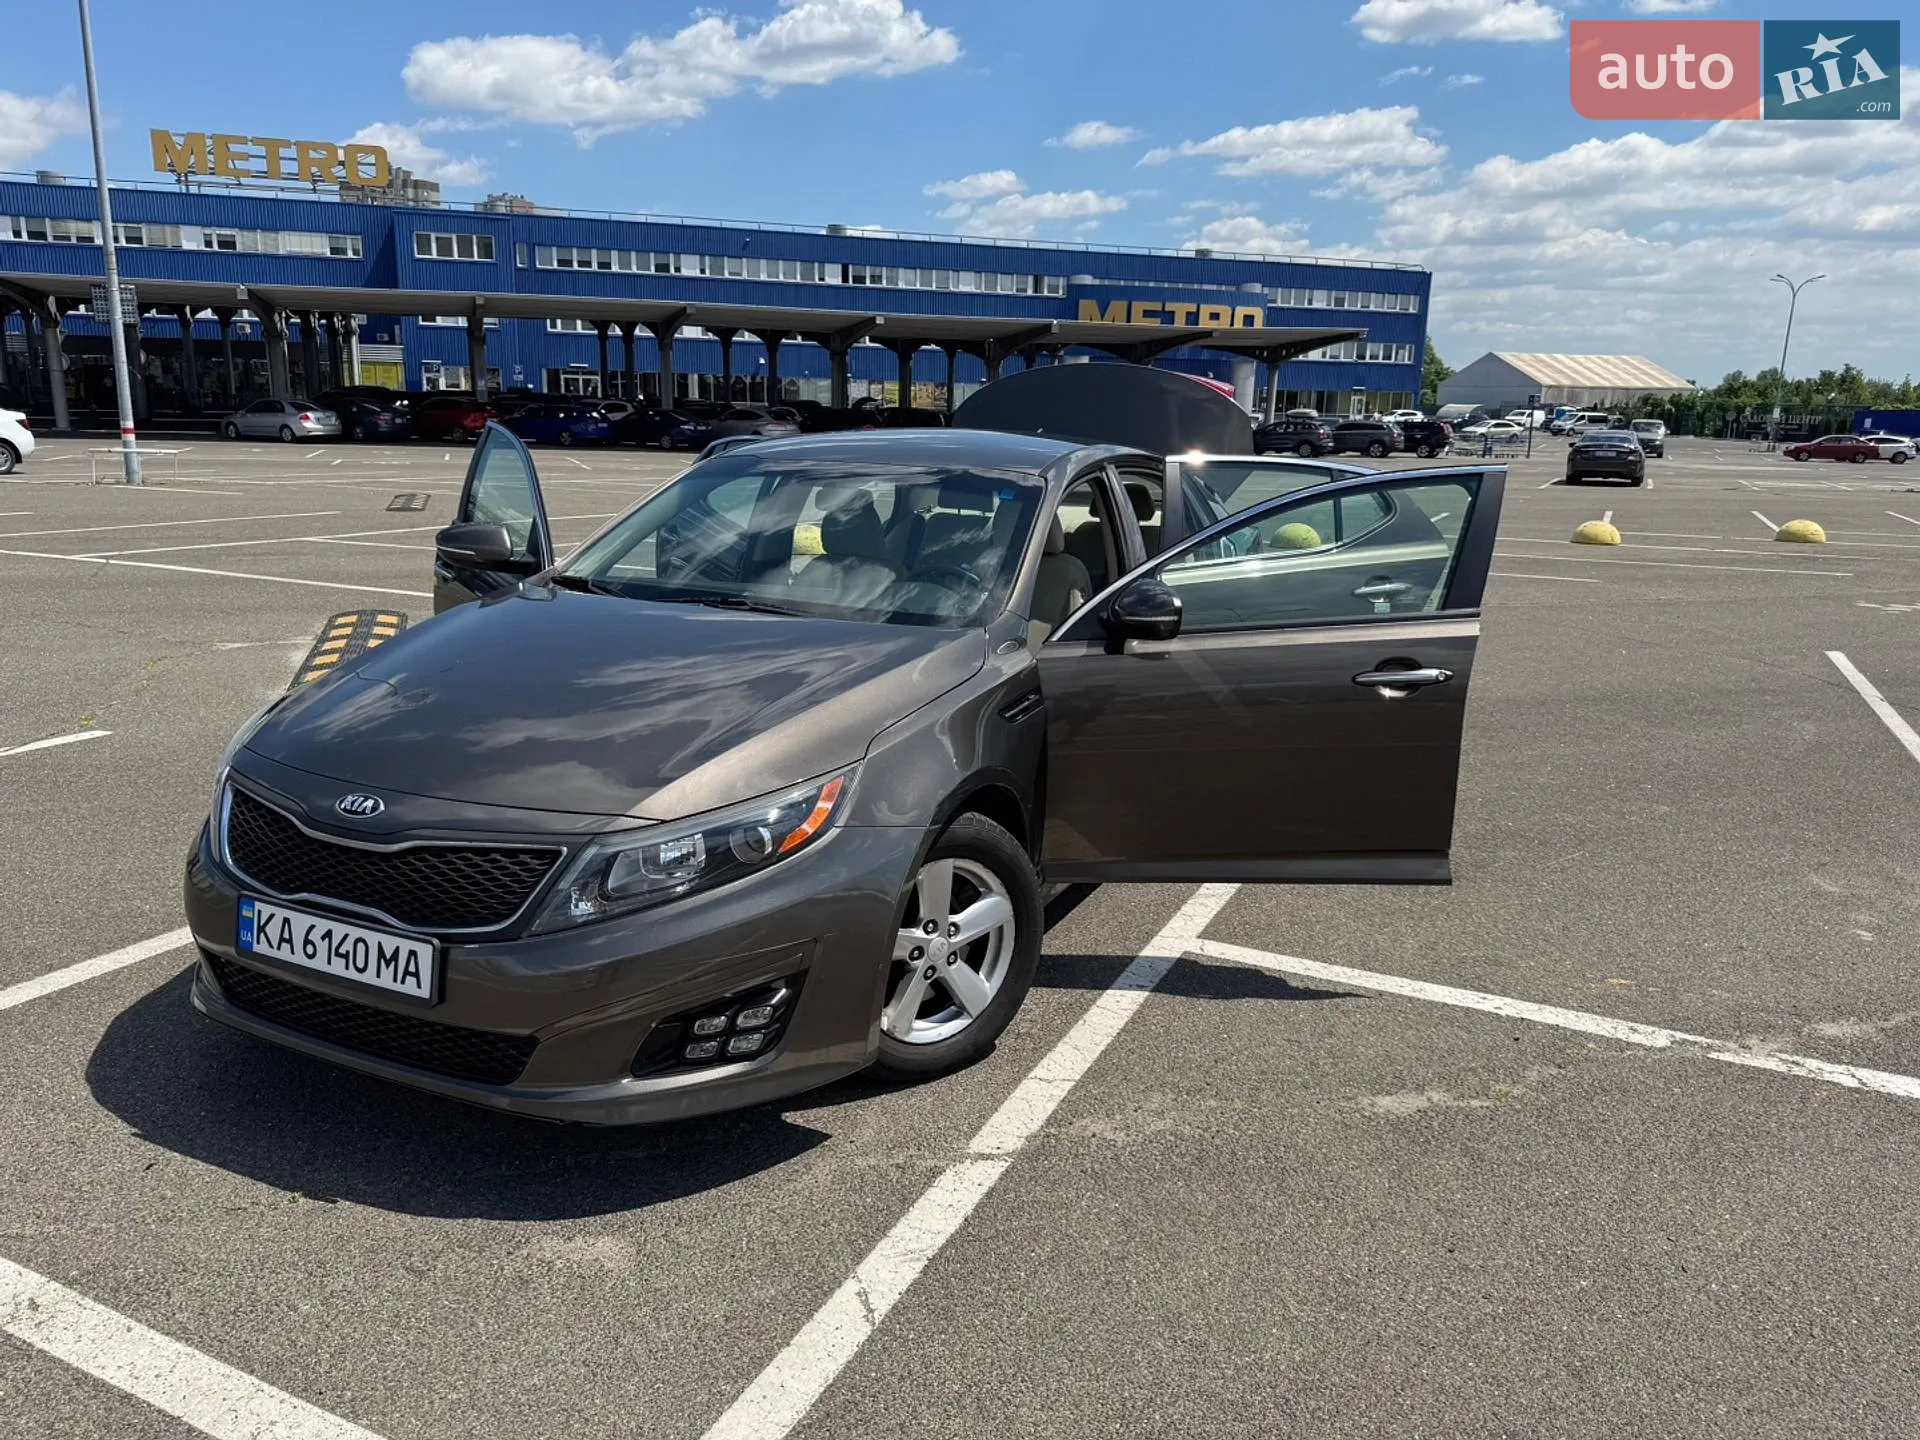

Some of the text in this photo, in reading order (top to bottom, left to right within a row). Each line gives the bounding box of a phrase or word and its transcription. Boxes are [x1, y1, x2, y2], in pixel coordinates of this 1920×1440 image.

[150, 128, 390, 187] METRO
[340, 795, 375, 814] KIA
[240, 929, 252, 943] UA
[256, 909, 422, 989] KA 6140 MA
